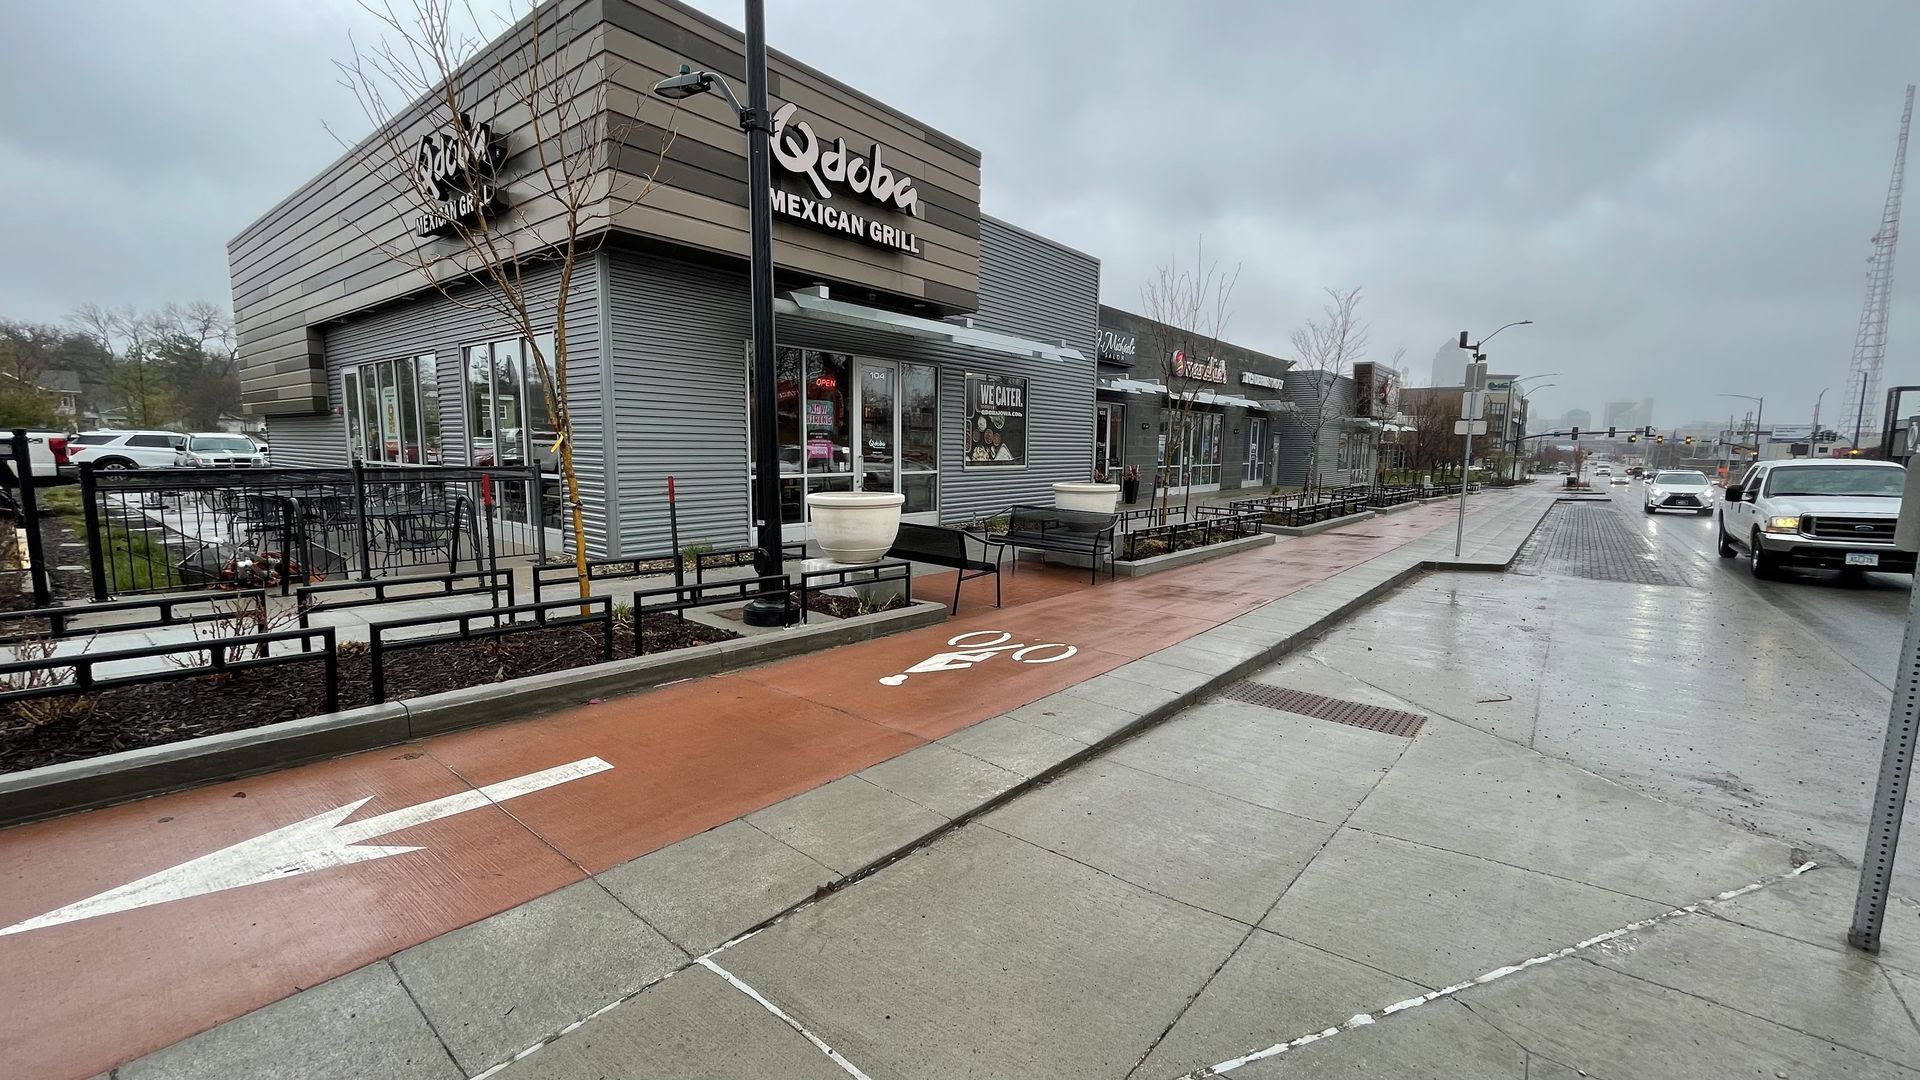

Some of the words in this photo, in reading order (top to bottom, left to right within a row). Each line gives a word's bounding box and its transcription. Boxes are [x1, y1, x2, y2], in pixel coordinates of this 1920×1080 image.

[770, 103, 918, 216] Qdoba
[770, 188, 864, 237] MEXICAN
[870, 220, 920, 254] GRILL
[1105, 352, 1125, 361] SALON
[816, 378, 837, 388] OPEN
[869, 371, 885, 380] 104
[980, 384, 994, 404] WE
[995, 386, 1023, 407] CATER.
